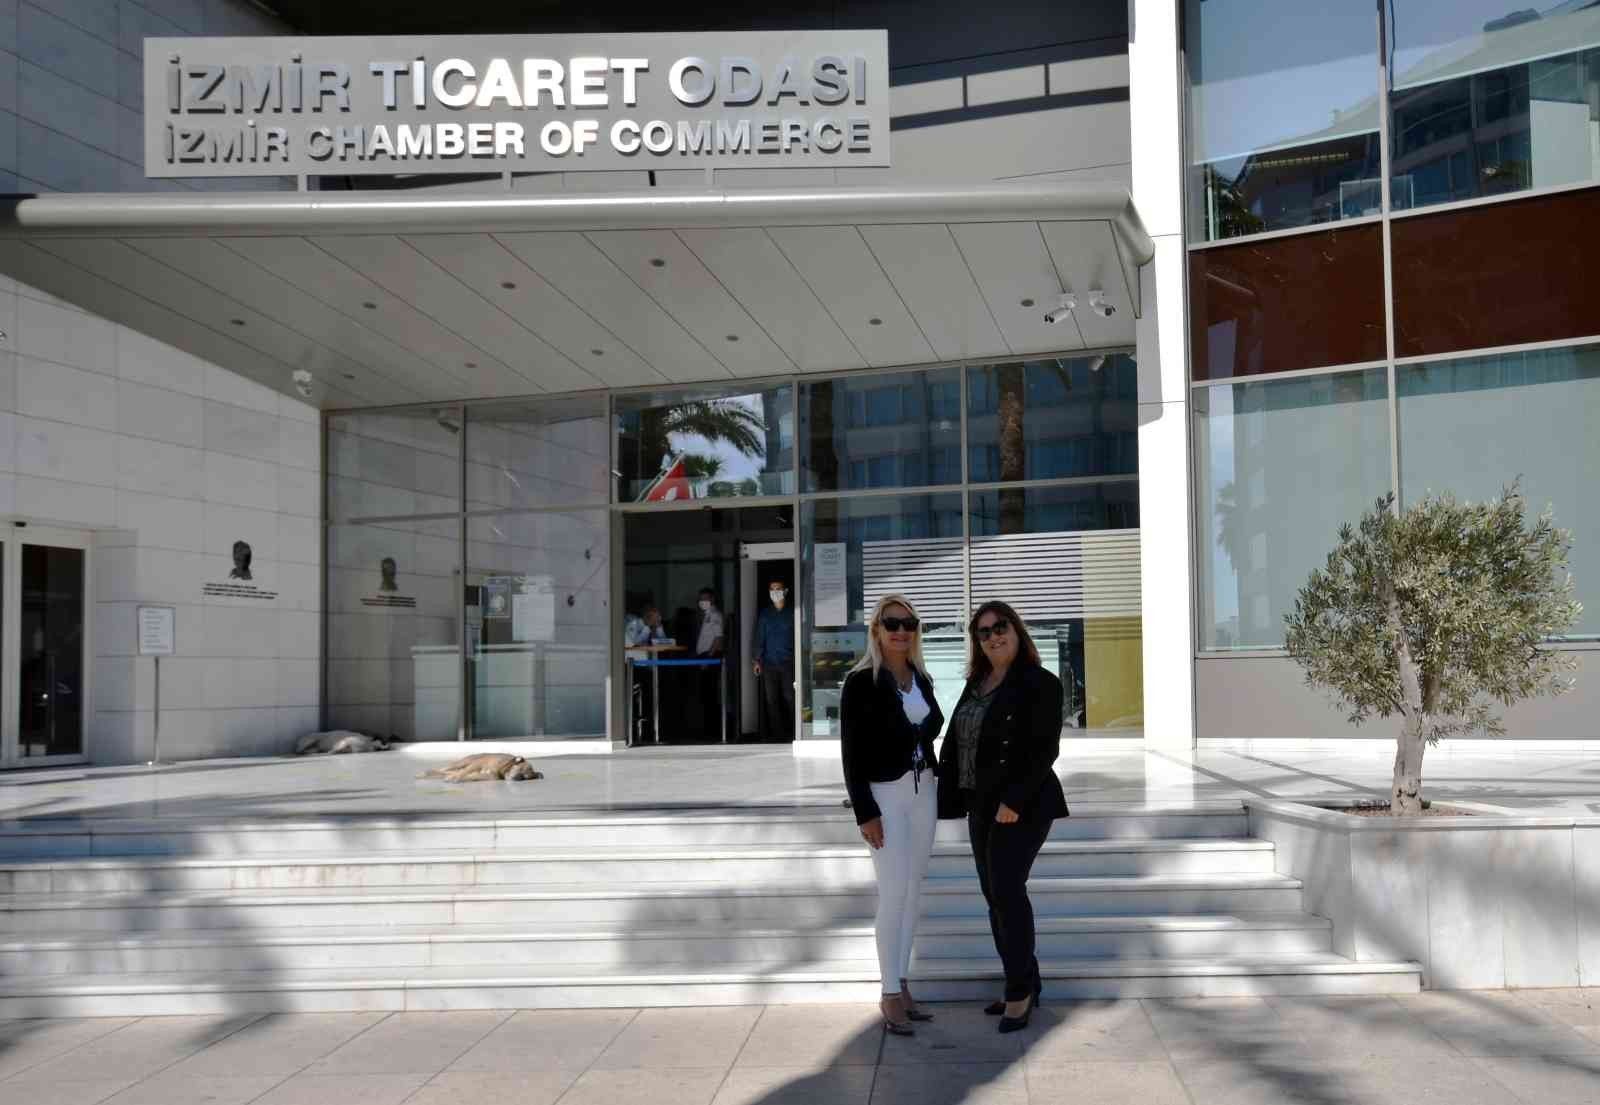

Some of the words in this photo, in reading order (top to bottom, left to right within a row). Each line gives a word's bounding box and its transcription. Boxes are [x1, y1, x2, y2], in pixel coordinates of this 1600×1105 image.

[668, 55, 867, 108] ODASI
[308, 121, 526, 162] CHAMBER
[540, 119, 600, 158] OF
[610, 117, 872, 157] COMMERCE
